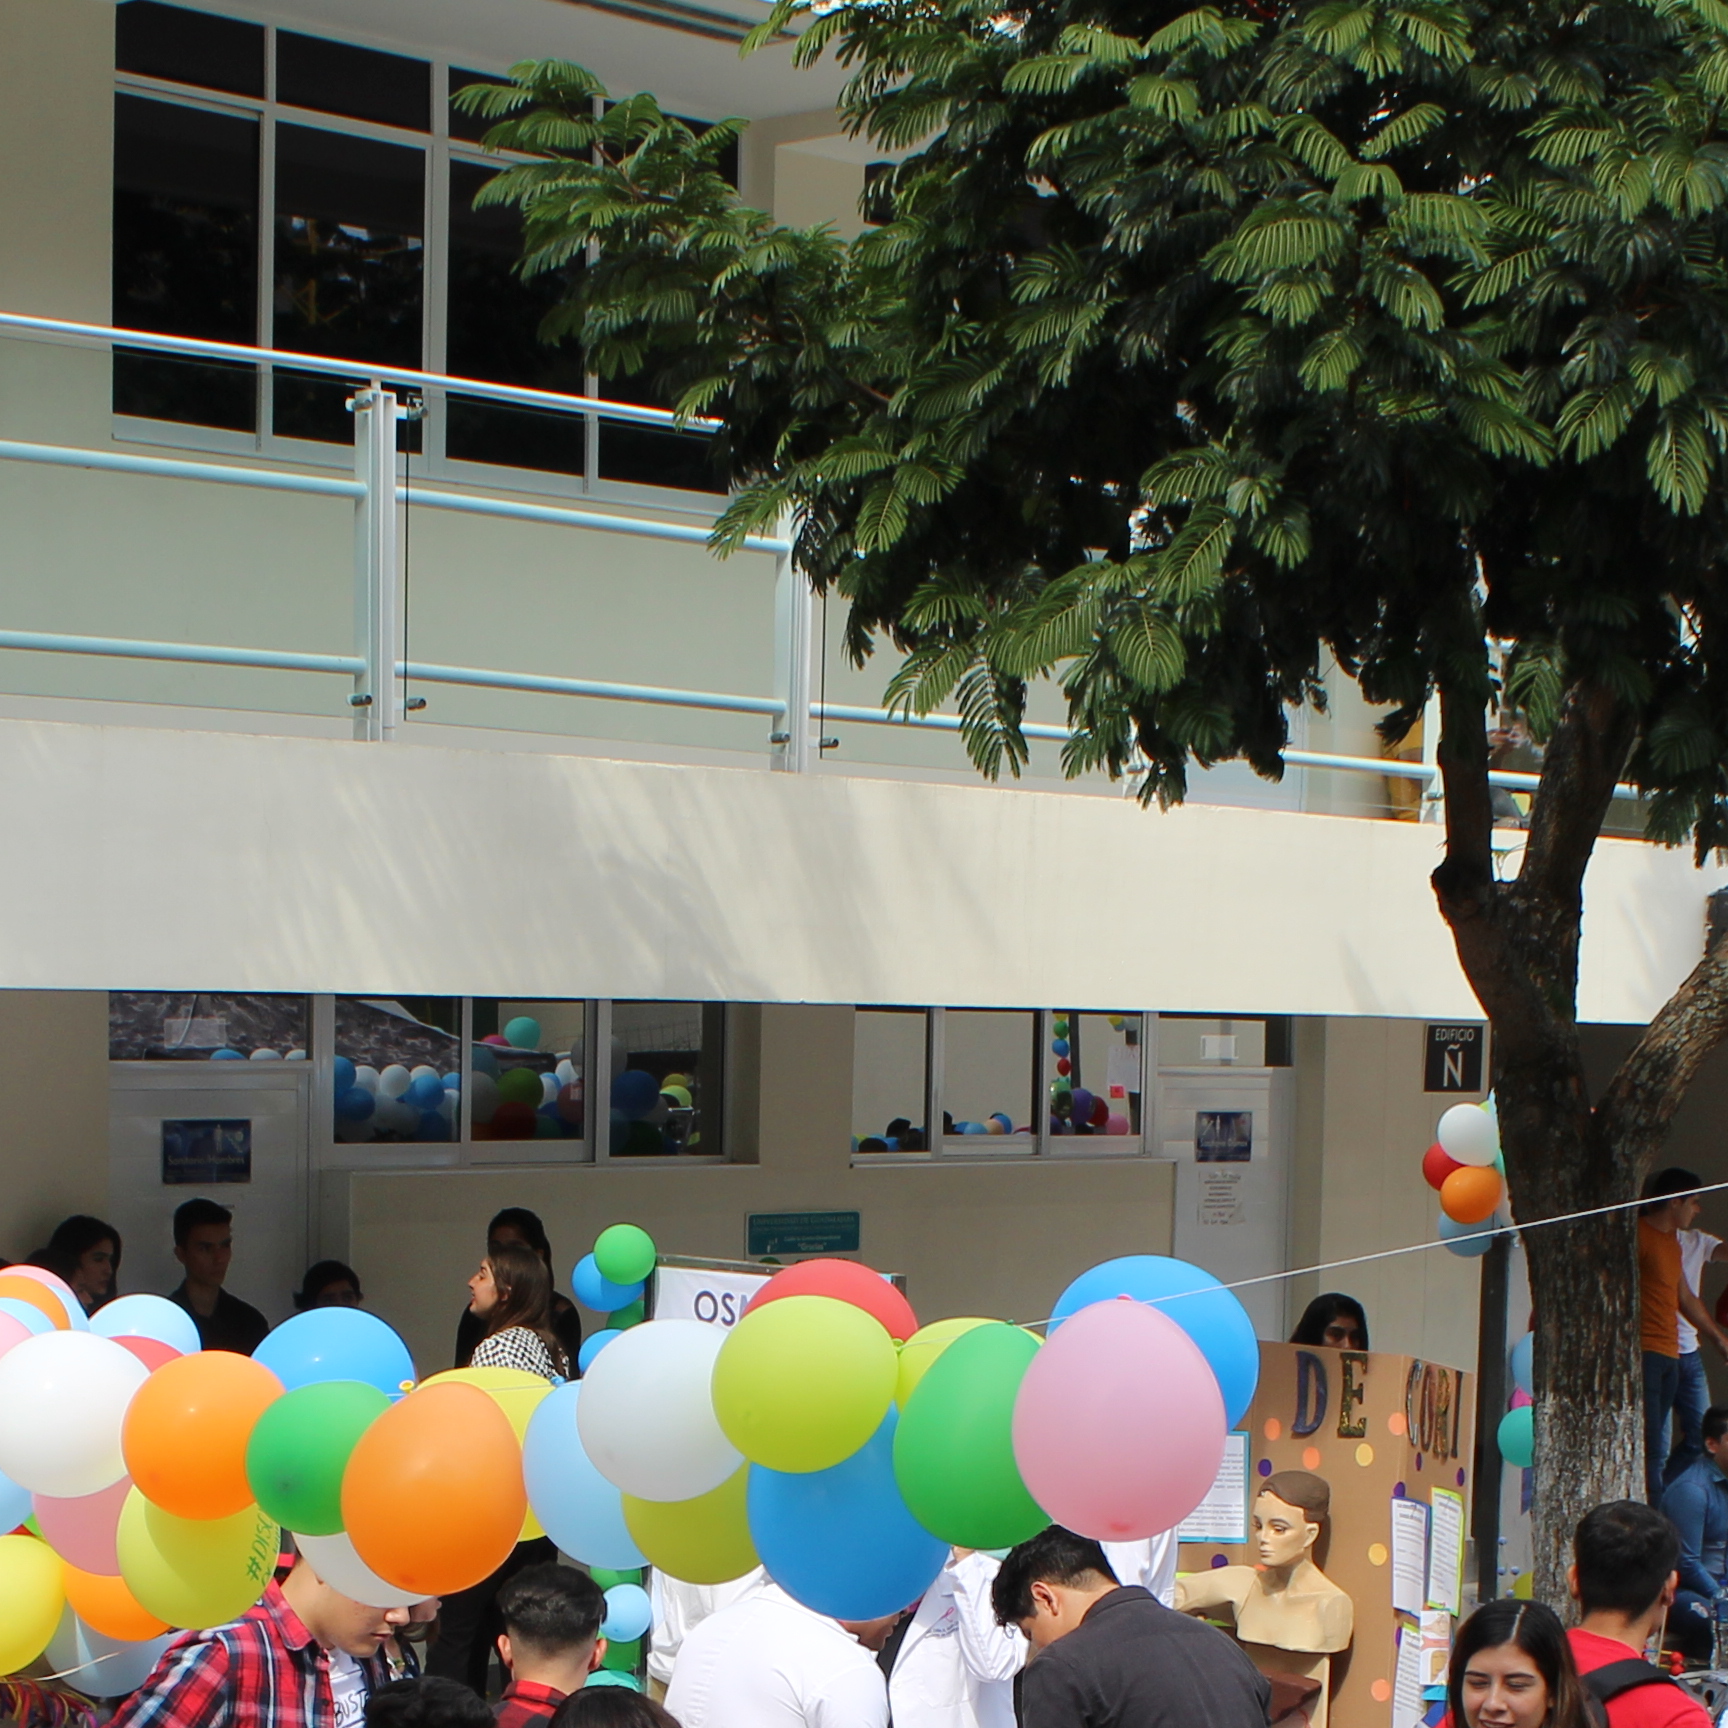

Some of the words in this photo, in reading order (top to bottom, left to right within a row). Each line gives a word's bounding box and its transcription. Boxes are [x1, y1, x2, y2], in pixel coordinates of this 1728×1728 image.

[1435, 1028, 1475, 1042] EDIFICIO
[1443, 1043, 1463, 1088] Ñ
[693, 1289, 748, 1327] OS
[1290, 1350, 1369, 1439] DE
